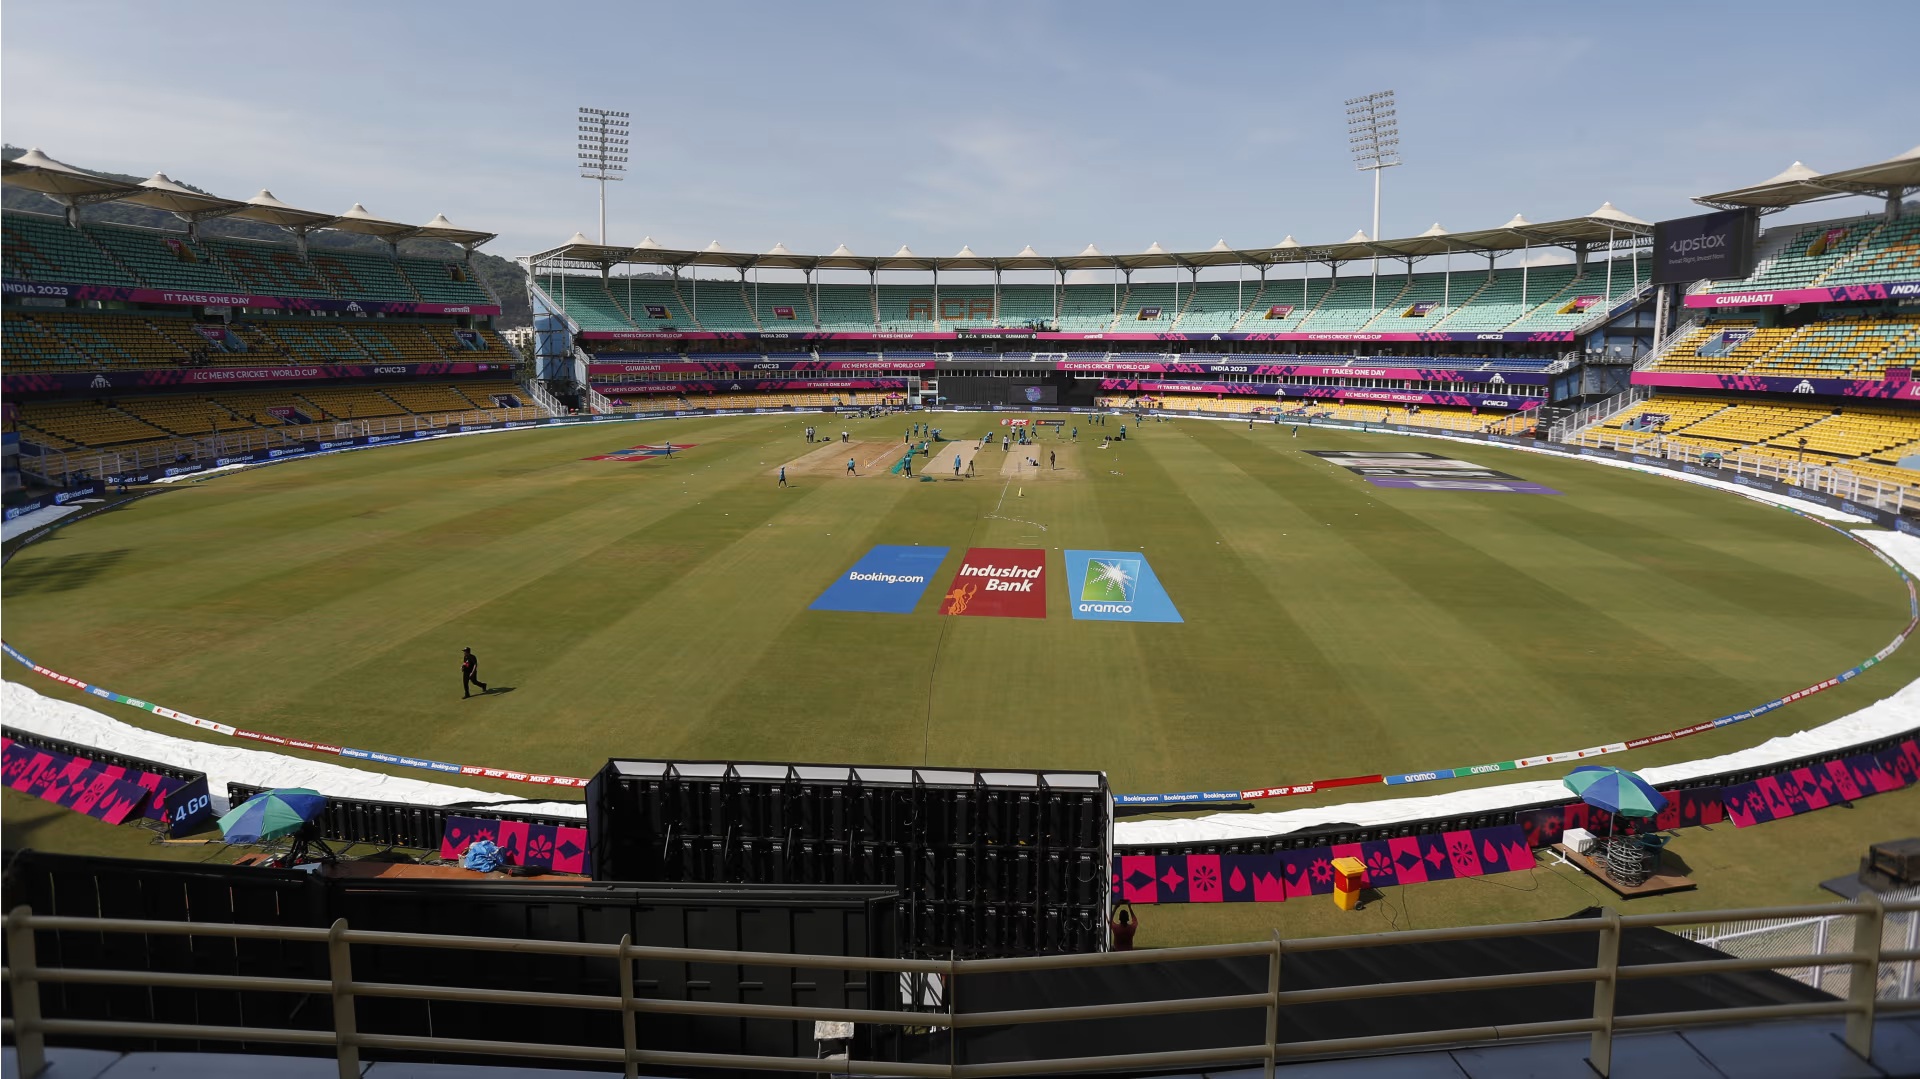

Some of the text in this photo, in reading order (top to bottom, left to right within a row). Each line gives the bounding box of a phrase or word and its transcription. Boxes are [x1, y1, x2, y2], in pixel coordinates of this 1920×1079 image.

[1670, 233, 1726, 256] upstox
[2, 282, 68, 296] INDIA 2023
[163, 293, 250, 305] IT TAKES ONE DAY
[1716, 294, 1774, 305] GUWAHATI
[193, 368, 318, 380] ICC MEN'S CRICKET WORLD CUP
[373, 365, 406, 374] #CWC23
[959, 563, 1042, 579] IndusInd
[849, 571, 924, 584] Booking.com
[985, 579, 1033, 592] Bank
[1078, 602, 1133, 614] aramco
[342, 748, 368, 758] Booking.com
[370, 753, 398, 762] Booking.com
[399, 758, 428, 767] Booking.com
[430, 762, 459, 771] Booking.com
[461, 766, 482, 775] MRF
[483, 769, 504, 777] MRF
[1470, 763, 1500, 774] aramco
[506, 772, 527, 780] MRF
[528, 775, 550, 783] MRF
[1404, 772, 1436, 783] aramco
[553, 777, 574, 785] MRF
[1242, 790, 1264, 798] MRF
[1267, 788, 1289, 796] MRF
[1292, 785, 1314, 794] MRF
[1123, 795, 1159, 803] Booking.com
[1163, 793, 1199, 801] Booking.com
[1203, 792, 1238, 800] Booking.com
[175, 805, 187, 822] 4
